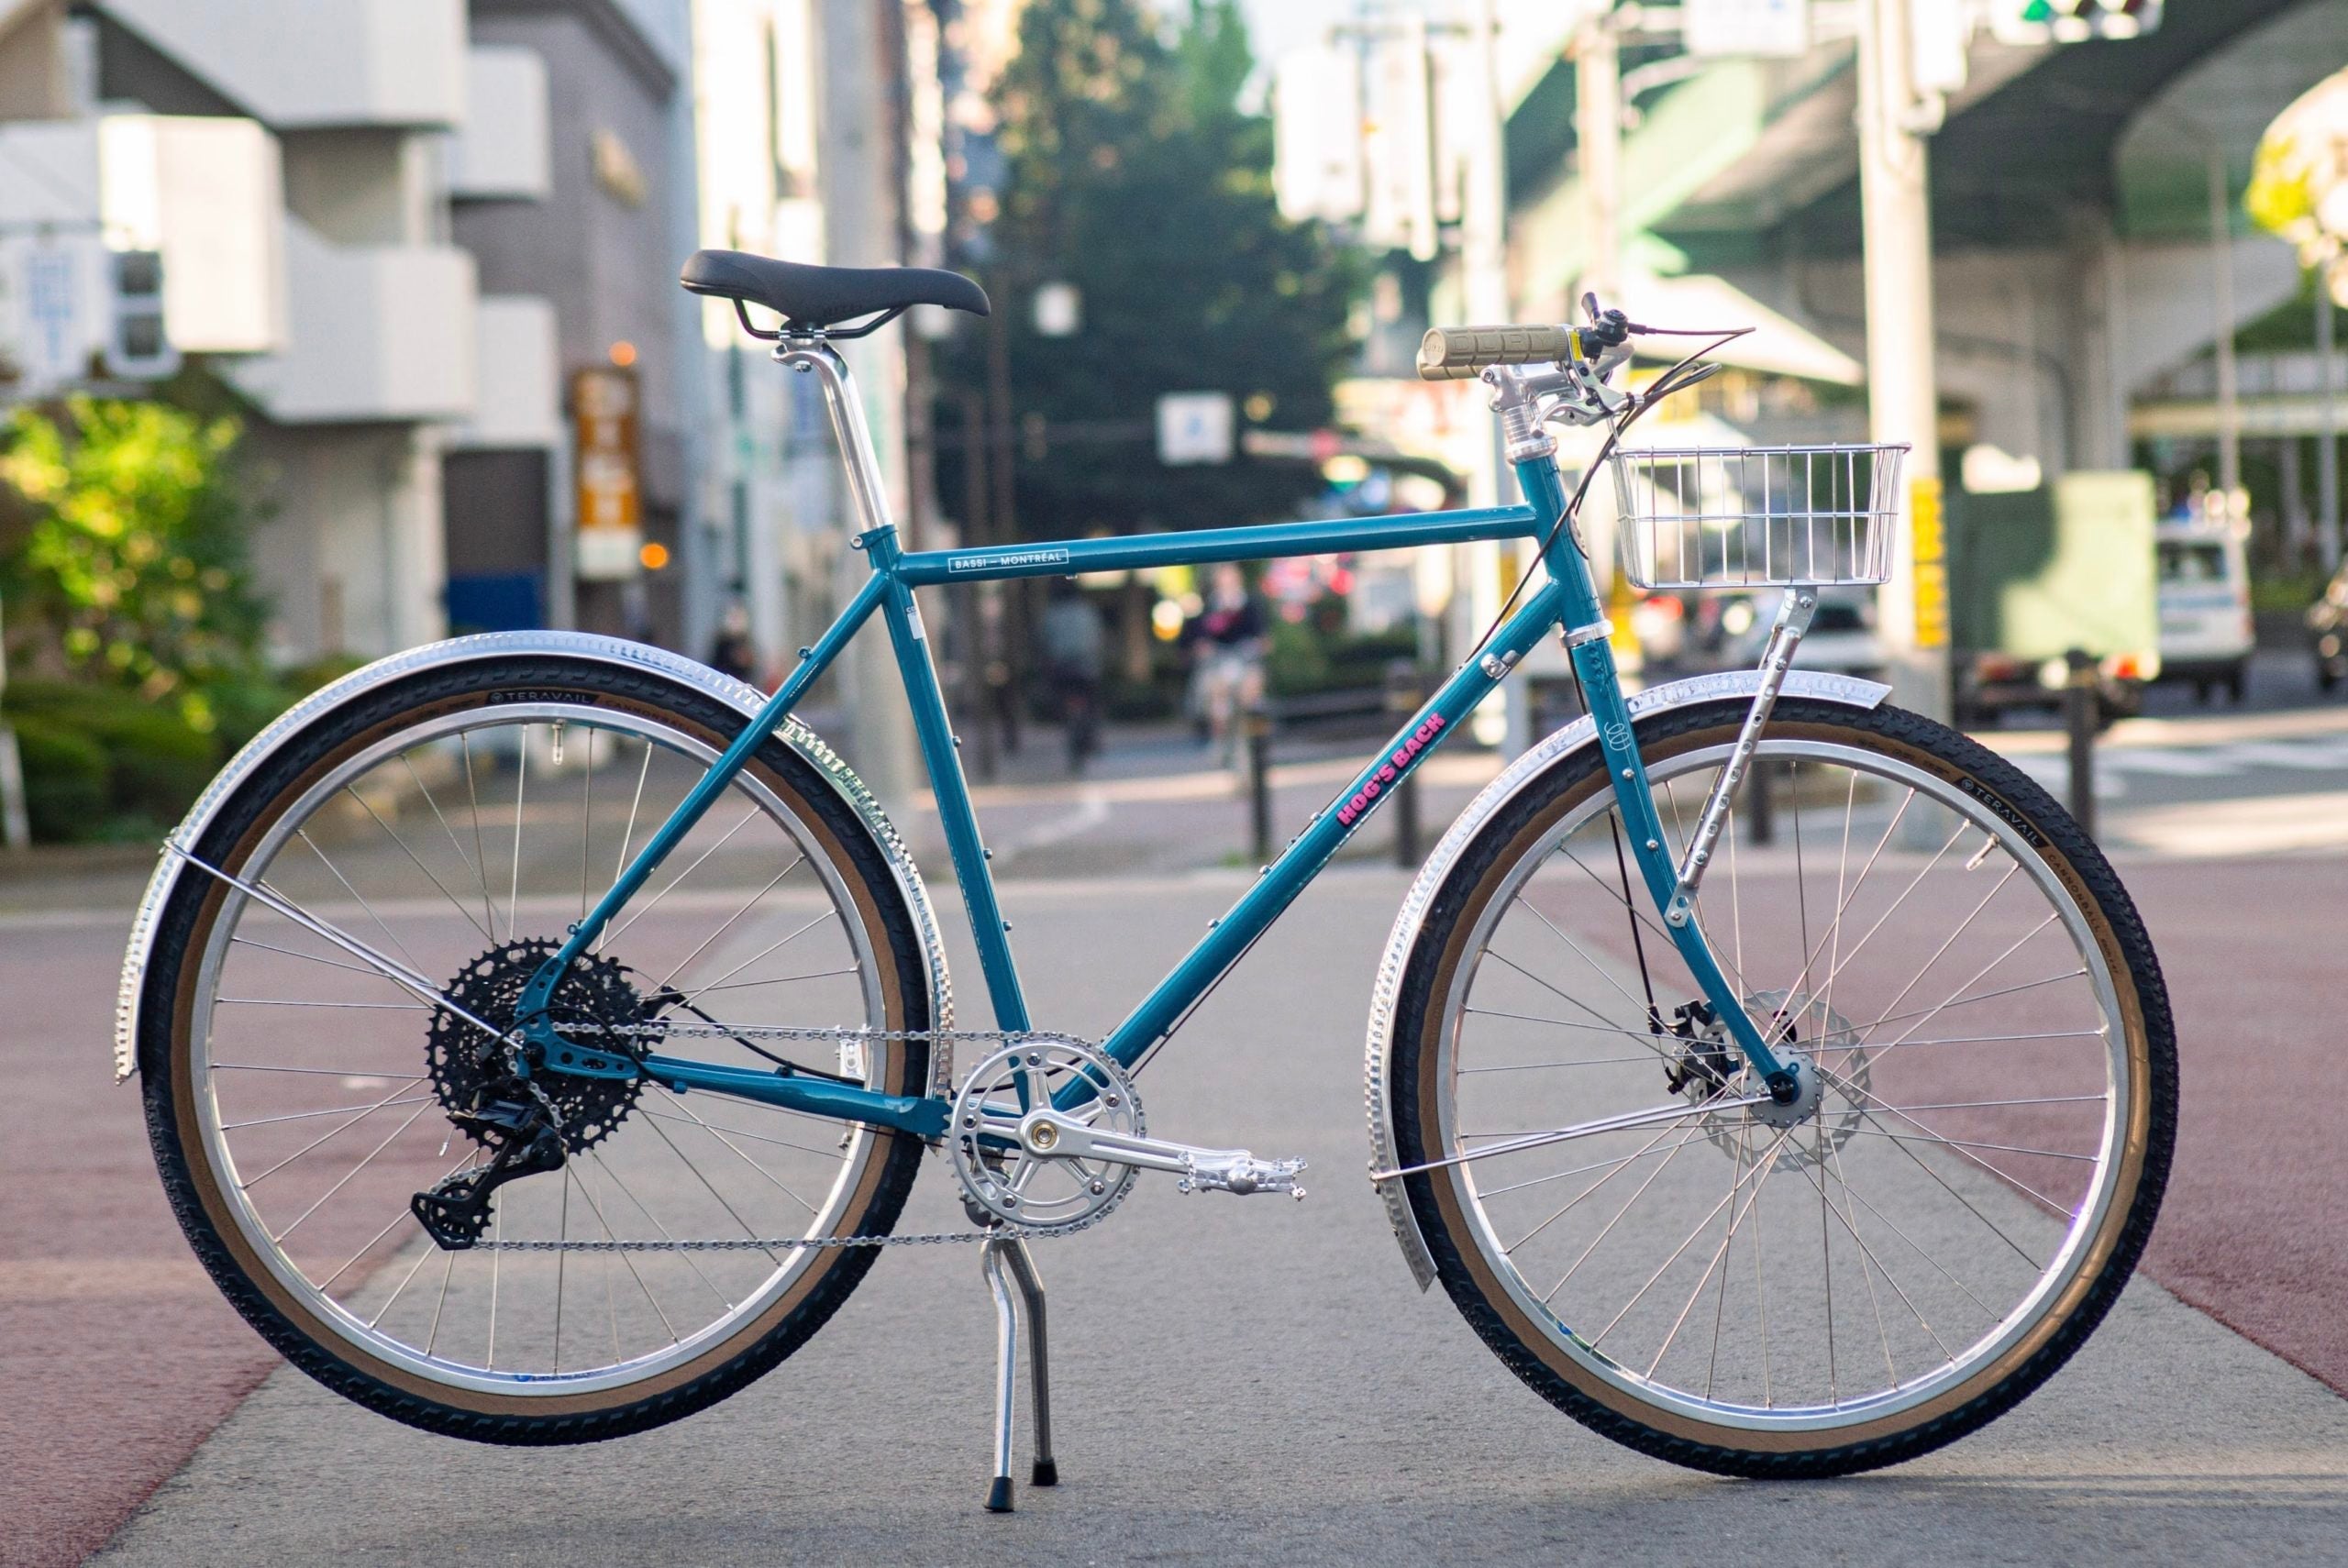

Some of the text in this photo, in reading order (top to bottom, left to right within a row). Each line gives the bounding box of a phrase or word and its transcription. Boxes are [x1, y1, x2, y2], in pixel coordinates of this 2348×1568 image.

[955, 558, 987, 569] BASSI
[1000, 552, 1062, 566] MONTRÉAL
[507, 691, 590, 703] TERAVAIL
[1336, 712, 1446, 826] HOG'S BACK
[1976, 787, 2041, 845] TERAVAIL
[2048, 855, 2100, 933] CANNONBALL
